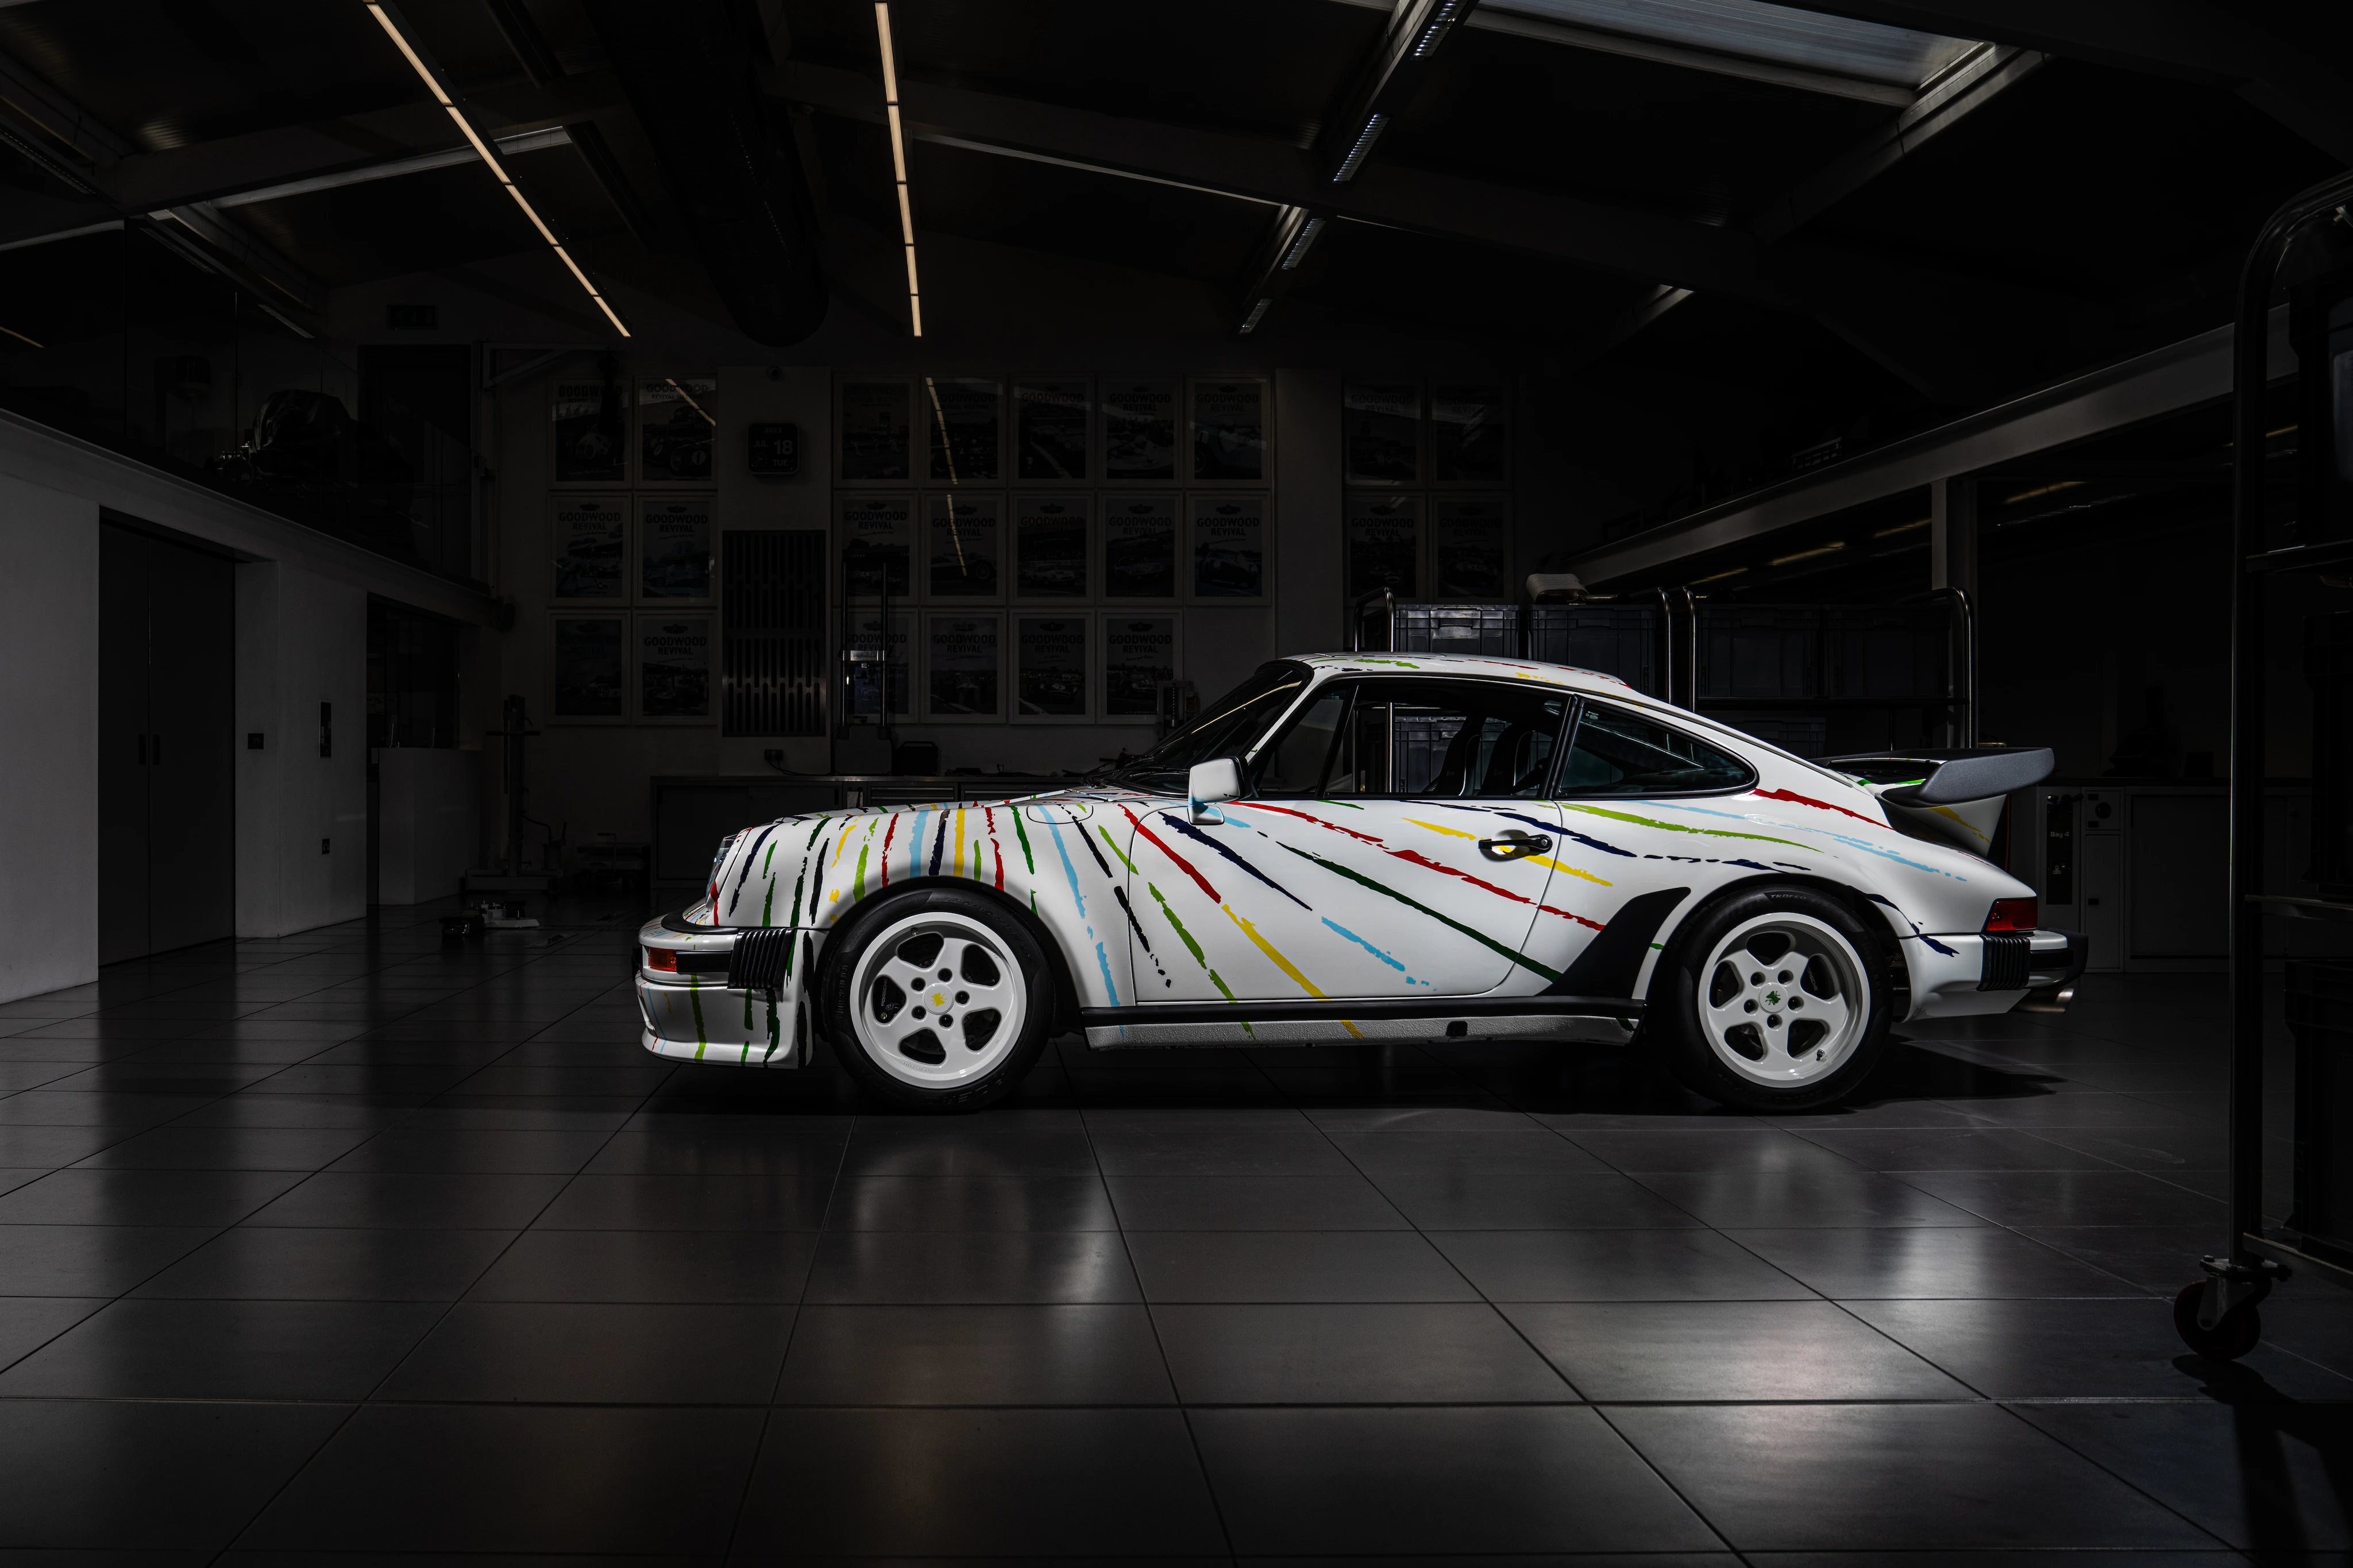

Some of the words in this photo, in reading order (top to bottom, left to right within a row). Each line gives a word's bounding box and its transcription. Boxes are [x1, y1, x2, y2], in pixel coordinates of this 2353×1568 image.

[558, 385, 623, 397] GOODWD
[1021, 393, 1083, 403] GOODWOOD
[1109, 393, 1171, 403] GOODWOOD
[1197, 394, 1259, 403] GOODWOOD
[1351, 394, 1414, 404] GOODWOOD
[1123, 403, 1158, 411] REVIVAL
[1210, 404, 1245, 412] REVIVAL
[1365, 404, 1399, 412] REVIVAL
[773, 439, 793, 455] 18
[559, 512, 620, 522] GOODWOOD
[646, 514, 708, 524] GOODWOOD
[844, 511, 907, 521] GOODWOOD
[1021, 516, 1084, 526] GOODWOOD
[1109, 517, 1171, 527] GOODWOOD
[1197, 517, 1259, 527] GOODWOOD
[1352, 518, 1414, 527] GOODWOOD
[1440, 518, 1502, 528] GOODWOOD
[659, 524, 694, 532] REVIVAL
[858, 522, 893, 530] REVIVAL
[947, 528, 982, 536] RVIVAL
[1123, 527, 1156, 535] REVIVAL
[1365, 528, 1401, 536] REVIVAL
[1453, 528, 1488, 536] REVIVAL
[645, 636, 707, 646] GOODWOOD
[933, 634, 996, 644] GOODWOOD
[1021, 635, 1083, 644] GOODWOOD
[1109, 635, 1171, 644] GOODWOOD
[658, 647, 693, 655] REVIVAL
[947, 644, 982, 652] REVIVAL
[1035, 645, 1070, 653] REVIVAL
[1123, 645, 1158, 653] REVIVAL
[1807, 968, 1818, 991] ORSCHE
